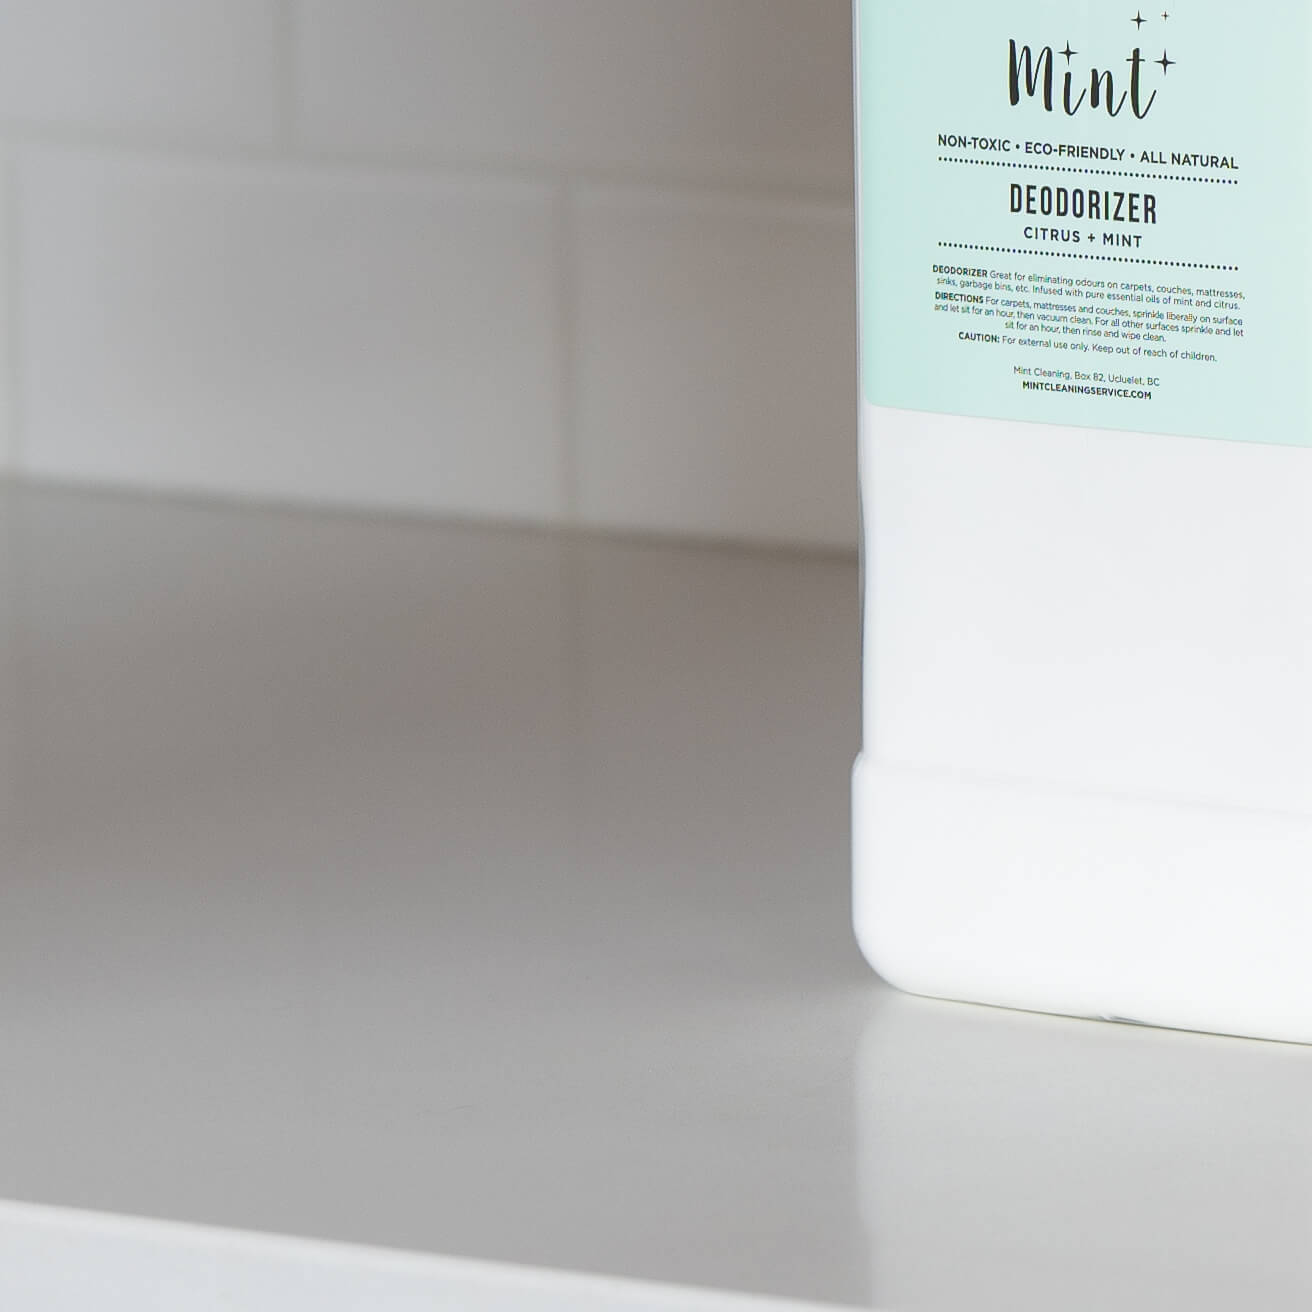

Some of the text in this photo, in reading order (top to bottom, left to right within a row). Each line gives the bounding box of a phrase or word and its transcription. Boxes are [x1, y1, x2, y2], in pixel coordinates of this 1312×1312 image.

[1009, 38, 1157, 119] Mint
[937, 133, 1239, 170] NON-TOXIC ECO-FRIENDLY ALL NATURAL
[1010, 183, 1157, 225] DEODORIZER
[1023, 226, 1081, 243] CITRUS
[1102, 232, 1143, 249] MINT
[932, 263, 988, 279] DEODORIZER
[989, 269, 1012, 281] Great
[1014, 271, 1026, 282] for
[1027, 273, 1074, 287] eliminating
[1074, 277, 1105, 289] odours
[1106, 281, 1118, 289] on
[959, 279, 993, 291] garbage
[1032, 284, 1063, 296] Infused
[1064, 285, 1084, 297] with
[1085, 290, 1105, 300] pure
[1106, 290, 1144, 303] essential
[1145, 294, 1161, 304] oils
[1161, 295, 1172, 305] of
[1173, 297, 1193, 307] mint
[1194, 298, 1212, 308] and
[934, 290, 984, 304] DIRECTIONS
[985, 295, 1000, 306] For
[1032, 302, 1077, 313] mattresses
[1077, 304, 1094, 314] and
[1132, 309, 1165, 320] sprinkle
[1166, 311, 1198, 324] liberally
[1199, 316, 1211, 324] on
[1212, 315, 1243, 326] surface
[934, 303, 949, 312] and
[949, 303, 960, 313] let
[960, 305, 971, 314] sit
[971, 304, 984, 315] for
[984, 308, 995, 316] an
[1016, 310, 1035, 320] then
[1036, 313, 1068, 323] vacuum
[1094, 316, 1109, 327] For
[1110, 318, 1120, 327] all
[1121, 318, 1144, 329] other
[1145, 321, 1180, 332] surfaces
[1180, 323, 1214, 335] sprinkle
[1214, 327, 1232, 336] and
[1232, 327, 1244, 337] let
[1004, 320, 1015, 330] sit
[1016, 320, 1028, 331] for
[1028, 324, 1040, 332] an
[1062, 325, 1081, 336] then
[1082, 326, 1102, 337] rinse
[1103, 329, 1120, 339] and
[1120, 330, 1141, 341] wipe
[958, 331, 1000, 344] CAUTION:
[1001, 335, 1017, 345] For
[1017, 337, 1052, 348] external
[1053, 341, 1068, 350] use
[1091, 343, 1114, 355] Keep
[1115, 345, 1130, 355] out
[1131, 346, 1142, 356] of
[1143, 348, 1168, 358] reach
[1169, 349, 1179, 359] of
[1013, 365, 1032, 376] Mint
[1074, 370, 1092, 381] Box
[1146, 376, 1160, 387] BC
[1022, 380, 1152, 401] MINTCLEANINGSERVICE.COM
